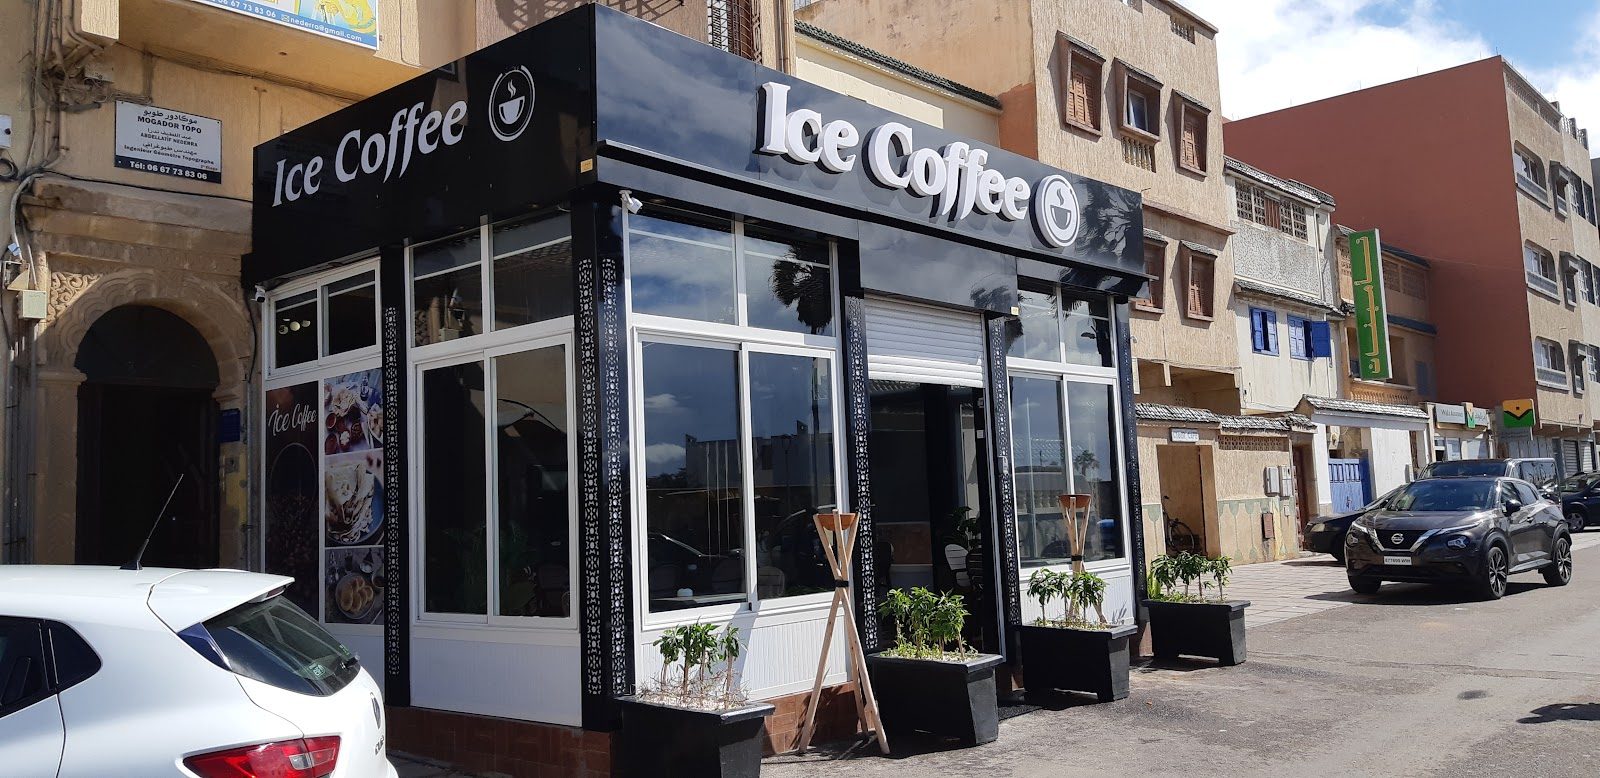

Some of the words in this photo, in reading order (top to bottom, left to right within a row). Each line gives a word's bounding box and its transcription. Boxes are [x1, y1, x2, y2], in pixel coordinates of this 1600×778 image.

[242, 3, 253, 11] 73
[254, 6, 264, 15] 83
[265, 9, 277, 18] 06
[290, 16, 363, 42] nederra@gmail.com
[137, 115, 180, 129] MOGADOR
[181, 124, 202, 134] TOPO
[271, 155, 324, 207] Ice
[334, 100, 467, 183] Coffee
[756, 81, 860, 173] Ice
[864, 121, 1031, 221] Coffee
[129, 160, 146, 170] Tél:
[147, 163, 158, 172] 06
[159, 166, 171, 174] 67
[172, 168, 183, 176] 73
[184, 170, 195, 178] 83
[196, 172, 207, 180] 06
[291, 403, 318, 431] Coffee
